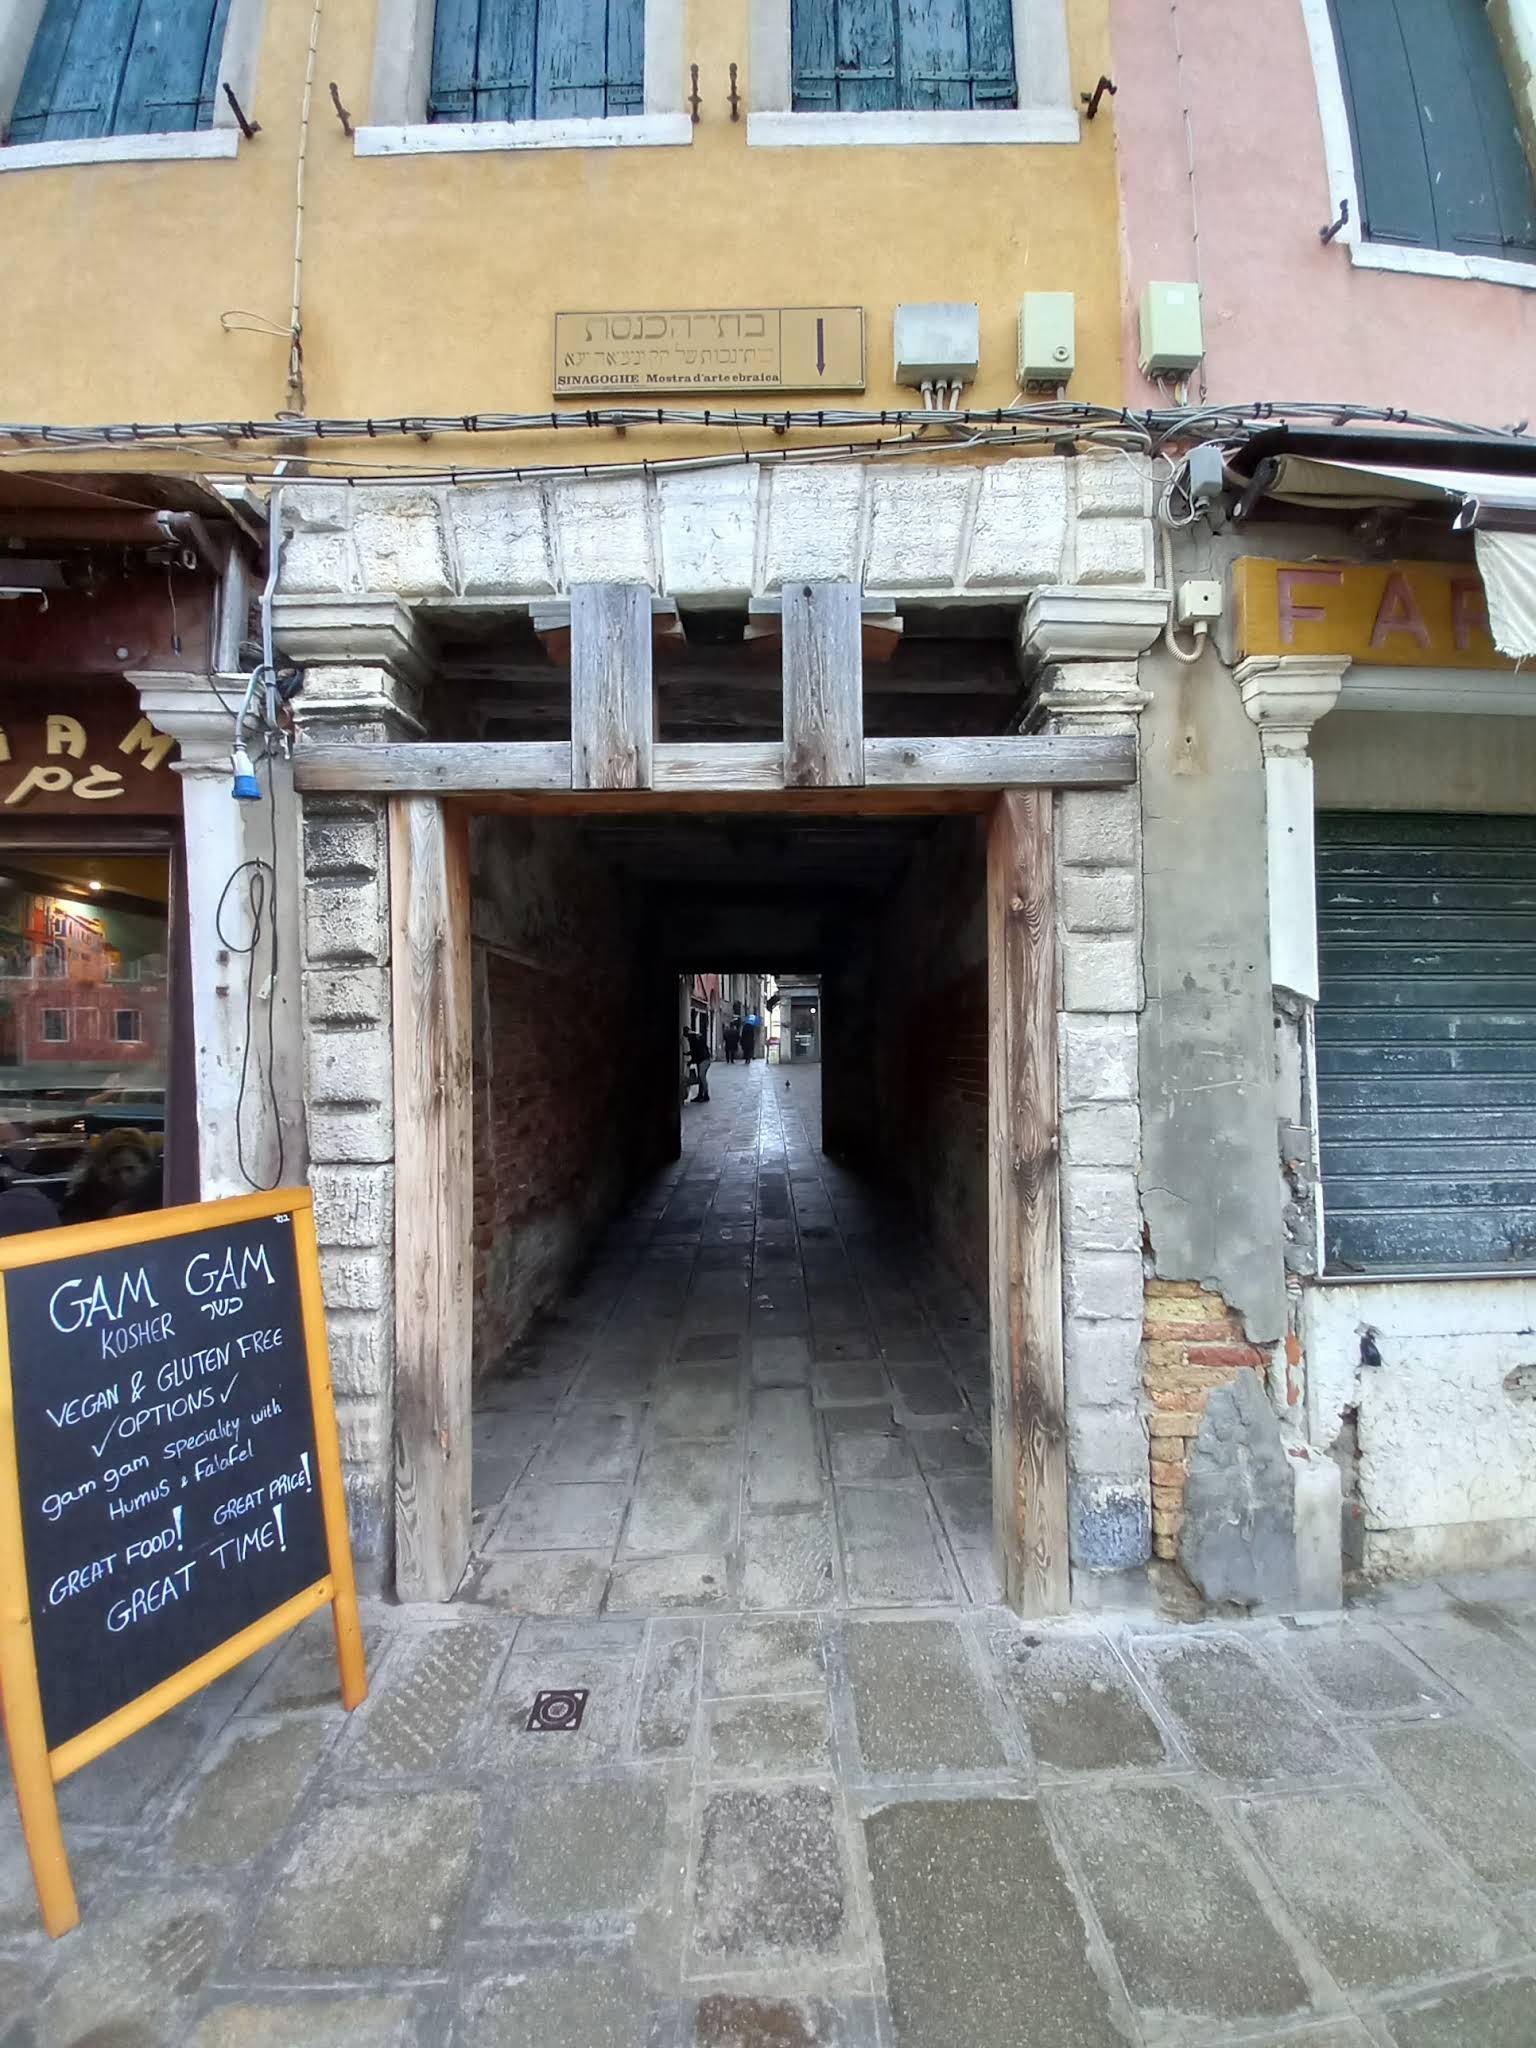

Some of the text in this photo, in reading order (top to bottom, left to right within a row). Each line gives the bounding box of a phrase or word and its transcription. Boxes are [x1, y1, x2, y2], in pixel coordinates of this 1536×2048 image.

[557, 374, 640, 385] SINAGOGHE
[646, 373, 692, 384] Mostra
[732, 372, 780, 382] ebraica
[49, 1243, 276, 1333] GAM GAM
[45, 1327, 283, 1428] VEGAN & GLUTEN FREE
[101, 1312, 175, 1360] KOSHER
[41, 1479, 97, 1521] gam
[103, 1454, 150, 1492] gam
[250, 1397, 283, 1425] with
[118, 1387, 215, 1438] OPTIONS
[49, 1451, 313, 1605] GREAT FOOD! GREAT PRICE!
[107, 1502, 287, 1632] GREAT TIME!
